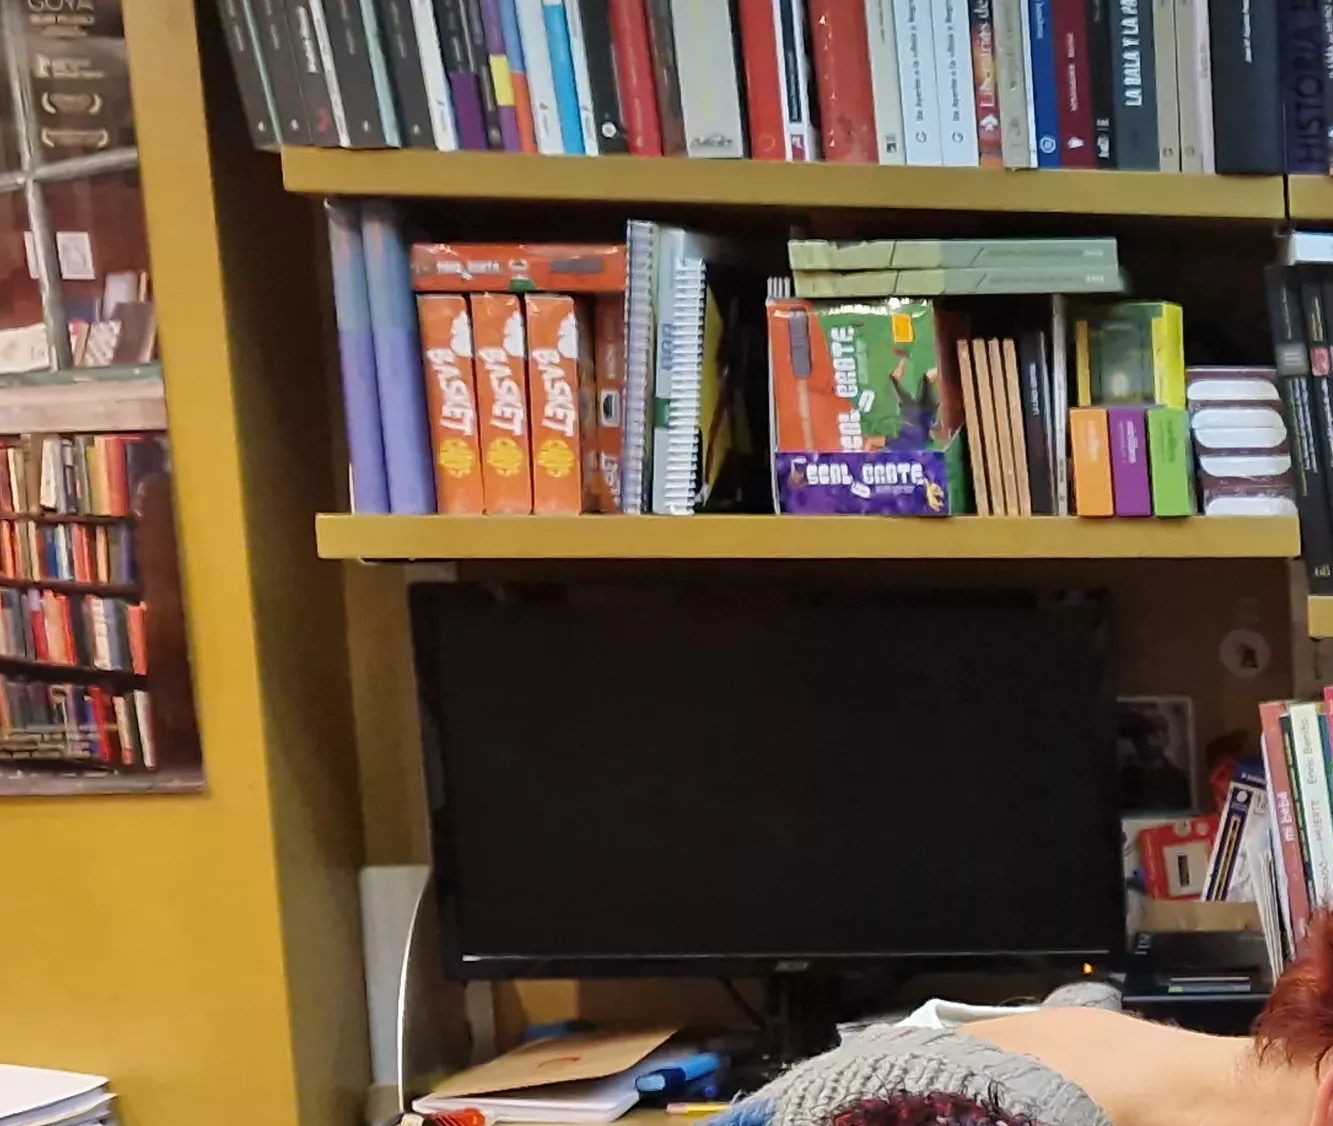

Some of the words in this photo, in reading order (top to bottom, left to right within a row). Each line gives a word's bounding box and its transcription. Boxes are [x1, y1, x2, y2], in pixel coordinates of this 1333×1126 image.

[1119, 16, 1139, 36] LA
[1120, 51, 1141, 86] BALA
[1123, 87, 1142, 106] LA
